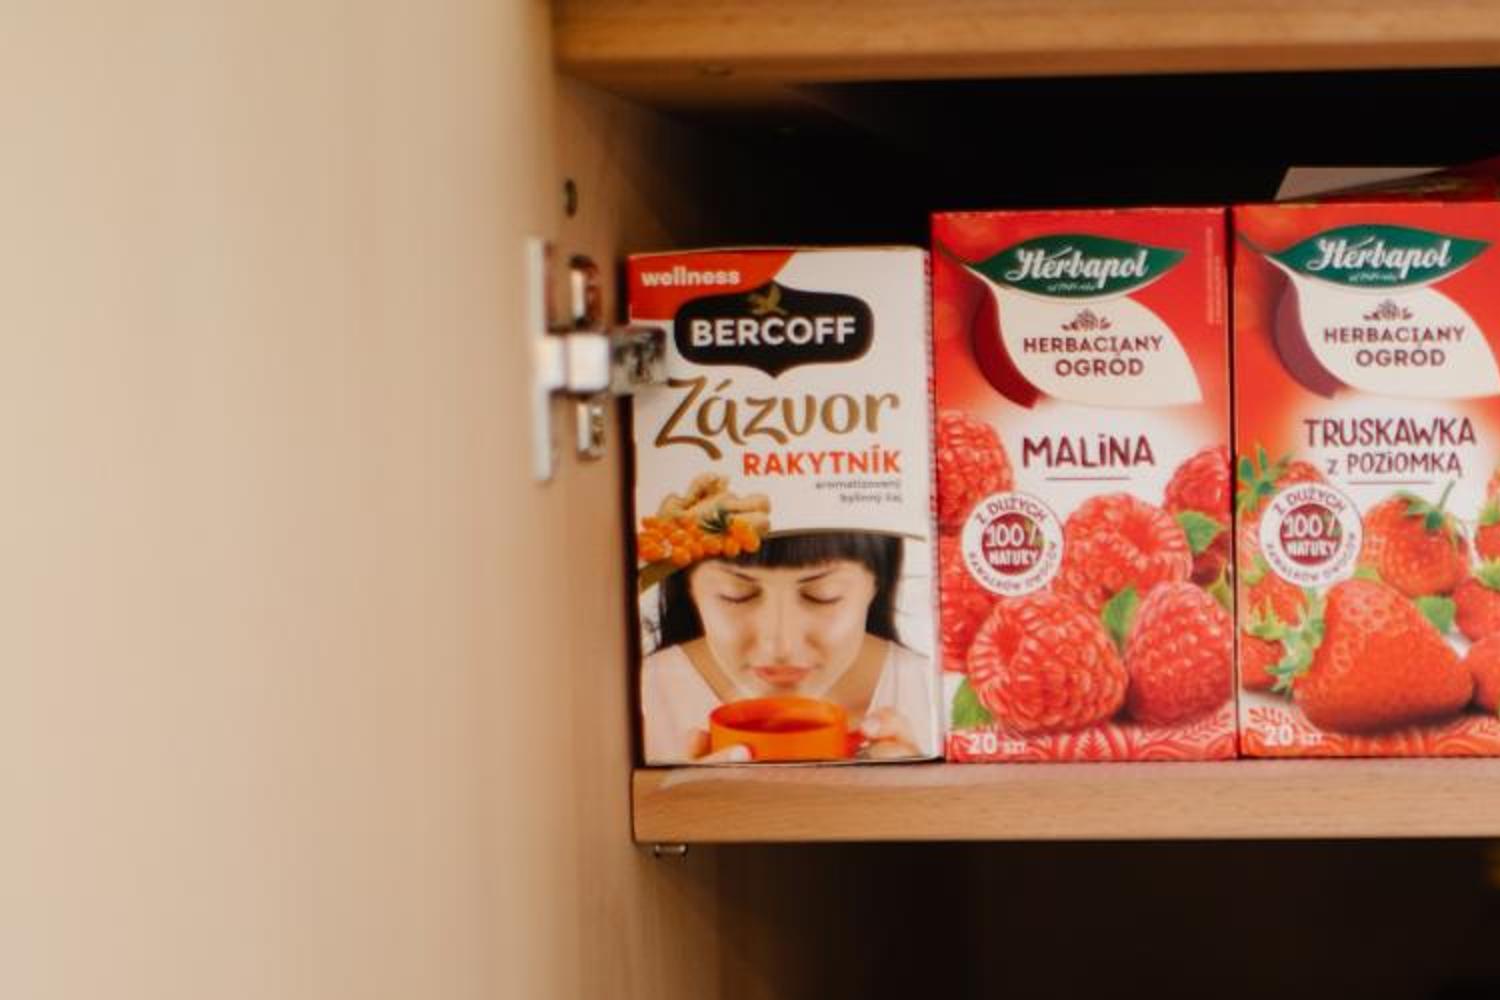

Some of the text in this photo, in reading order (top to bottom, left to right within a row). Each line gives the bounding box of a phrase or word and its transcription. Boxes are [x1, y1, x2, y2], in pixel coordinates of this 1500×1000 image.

[1005, 246, 1150, 290] Herbapol
[1306, 236, 1452, 280] Herbapol
[641, 266, 741, 287] wellness
[691, 316, 856, 347] BERCOFF
[1023, 334, 1164, 353] HERBACIANY
[1323, 325, 1465, 344] HERBACIANY
[1055, 352, 1145, 377] OGRÓD
[1355, 343, 1446, 367] OGRÓD
[654, 376, 901, 461] Zázvor
[1303, 416, 1477, 448] TRUSKAWKA
[743, 444, 902, 477] RAKYTNÍK
[1327, 458, 1339, 475] z
[1286, 539, 1338, 557] NATURY
[969, 735, 997, 754] 20
[1263, 726, 1294, 746] 20
